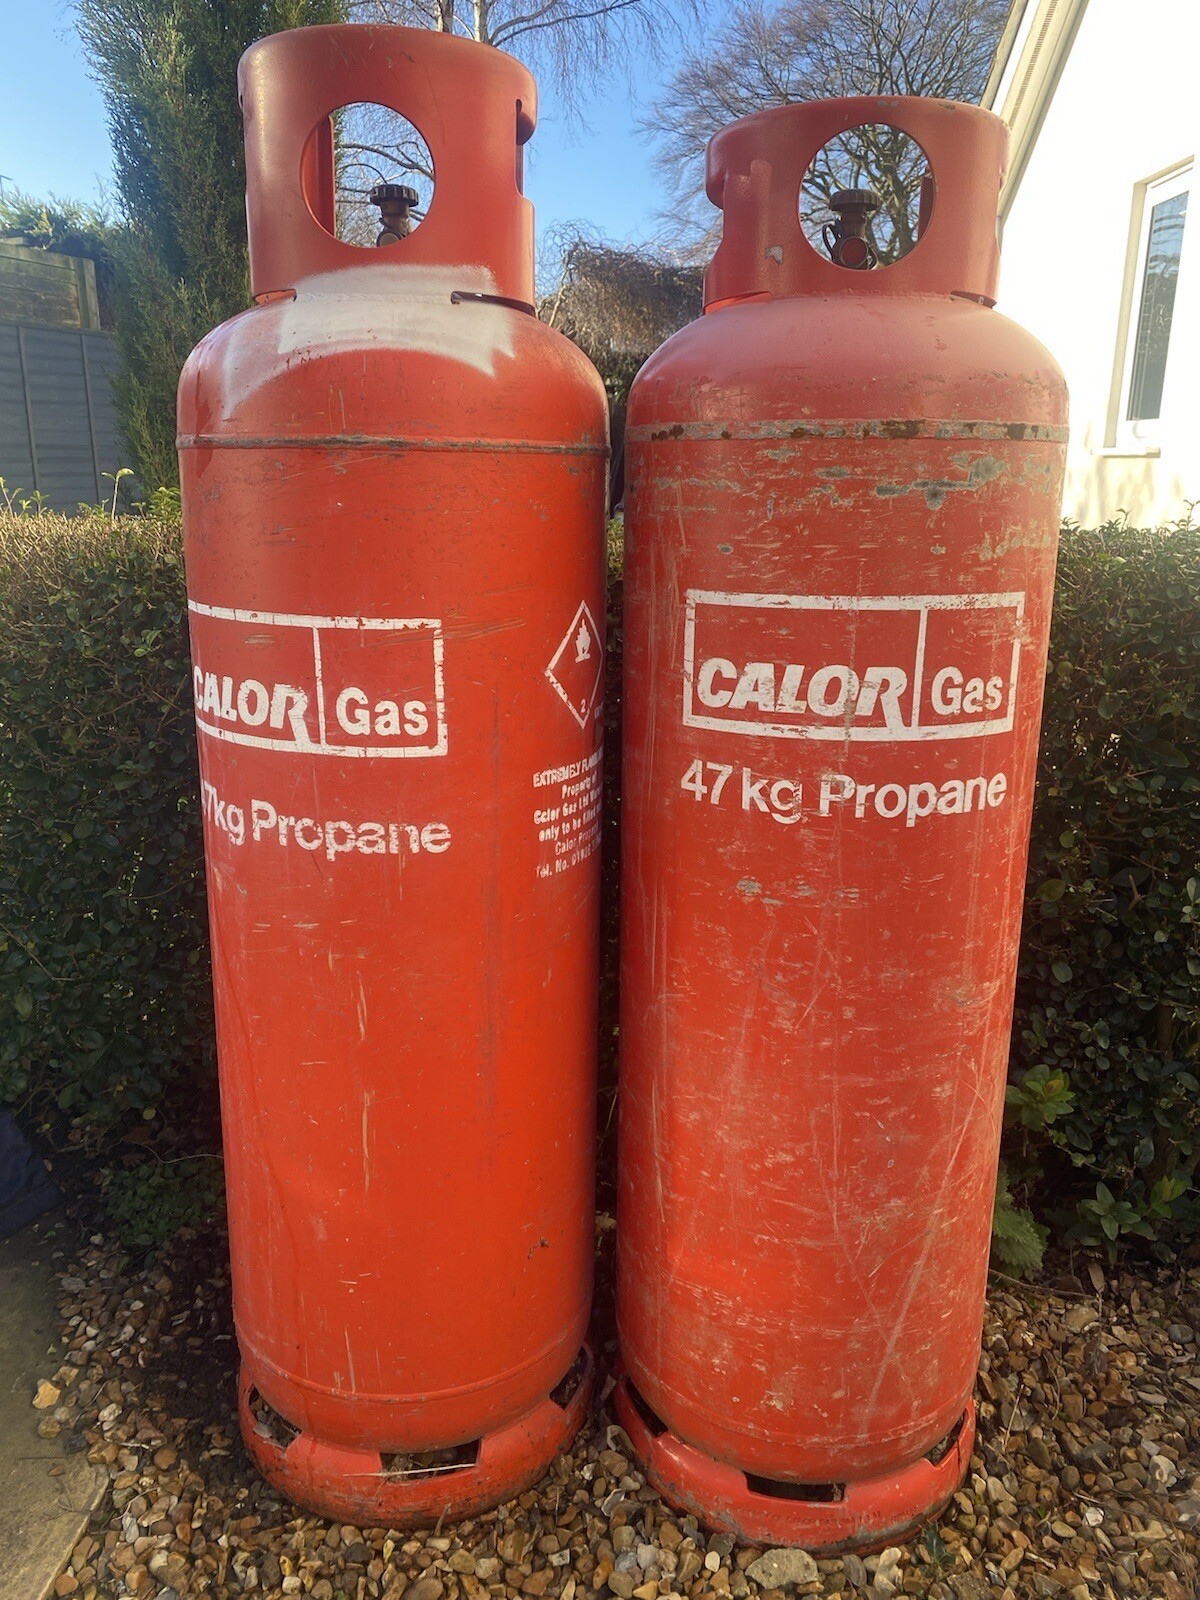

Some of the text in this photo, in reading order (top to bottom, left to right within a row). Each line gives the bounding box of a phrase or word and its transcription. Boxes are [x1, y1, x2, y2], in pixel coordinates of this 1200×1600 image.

[193, 664, 429, 744] CALOR Gas
[697, 657, 1003, 727] CALOR Gas
[533, 761, 581, 788] EXTREMELY
[680, 759, 1007, 828] 47 kg Propane
[533, 807, 560, 825] Calor
[562, 802, 577, 817] Gas
[251, 799, 452, 862] Propane
[539, 825, 560, 842] only
[562, 822, 570, 835] to
[573, 817, 581, 831] be
[555, 837, 577, 856] Calor
[534, 864, 553, 878] Tel.
[556, 859, 570, 874] No.
